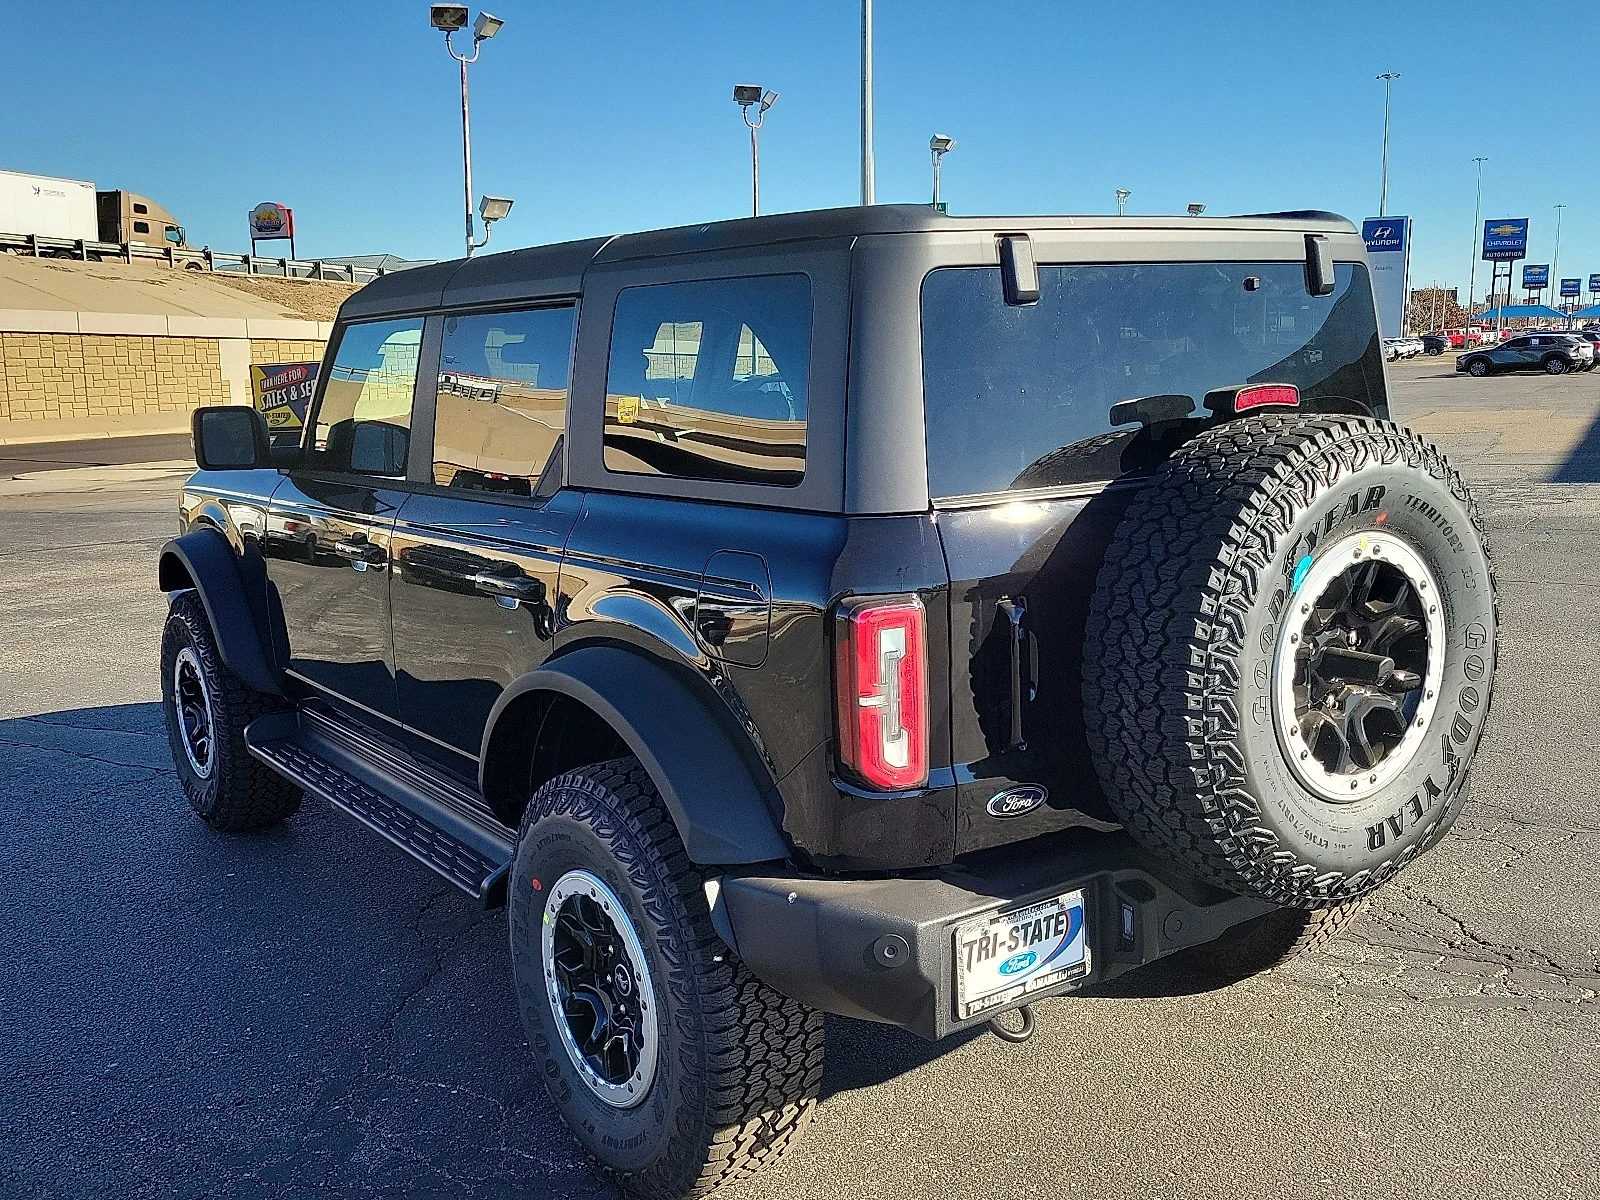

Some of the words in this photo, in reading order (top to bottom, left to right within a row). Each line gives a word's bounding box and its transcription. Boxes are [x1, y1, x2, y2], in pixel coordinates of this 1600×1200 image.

[273, 373, 289, 386] HERE
[288, 368, 302, 382] FOR
[260, 388, 288, 411] SALES
[290, 385, 298, 401] &
[1405, 494, 1464, 553] TERRITORY
[1002, 793, 1034, 812] Ford
[963, 911, 1066, 973] TRI-STATE
[1005, 954, 1032, 973] Ford
